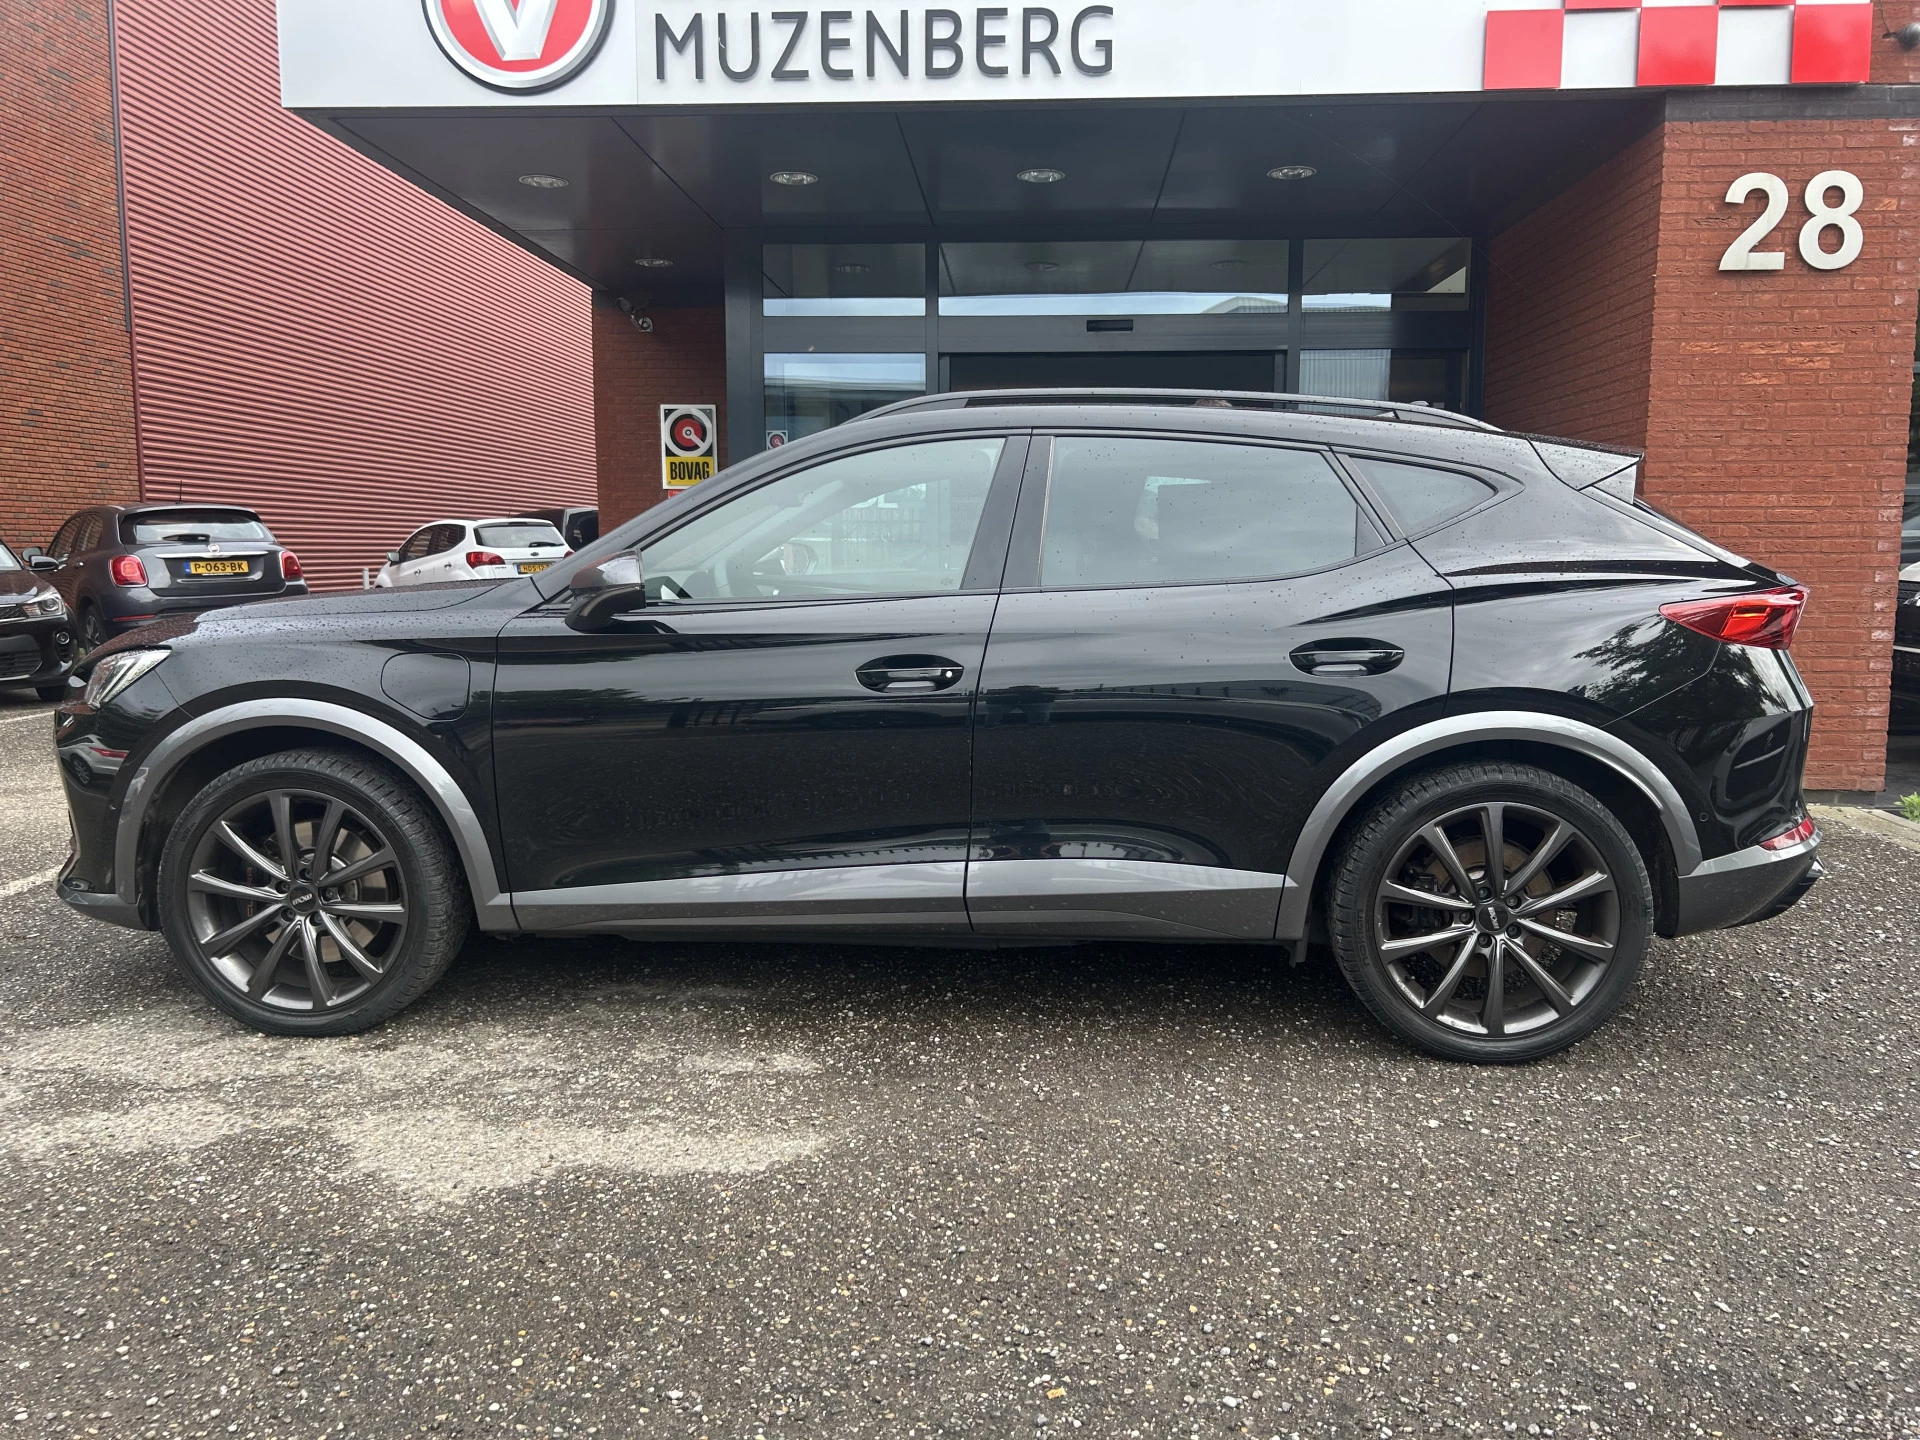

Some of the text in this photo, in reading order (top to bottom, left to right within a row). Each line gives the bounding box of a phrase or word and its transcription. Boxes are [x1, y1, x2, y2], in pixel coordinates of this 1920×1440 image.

[655, 5, 1113, 80] MUZENBERG
[1719, 170, 1864, 270] 28
[670, 461, 710, 480] BOVAG
[194, 563, 245, 572] P-063-BK
